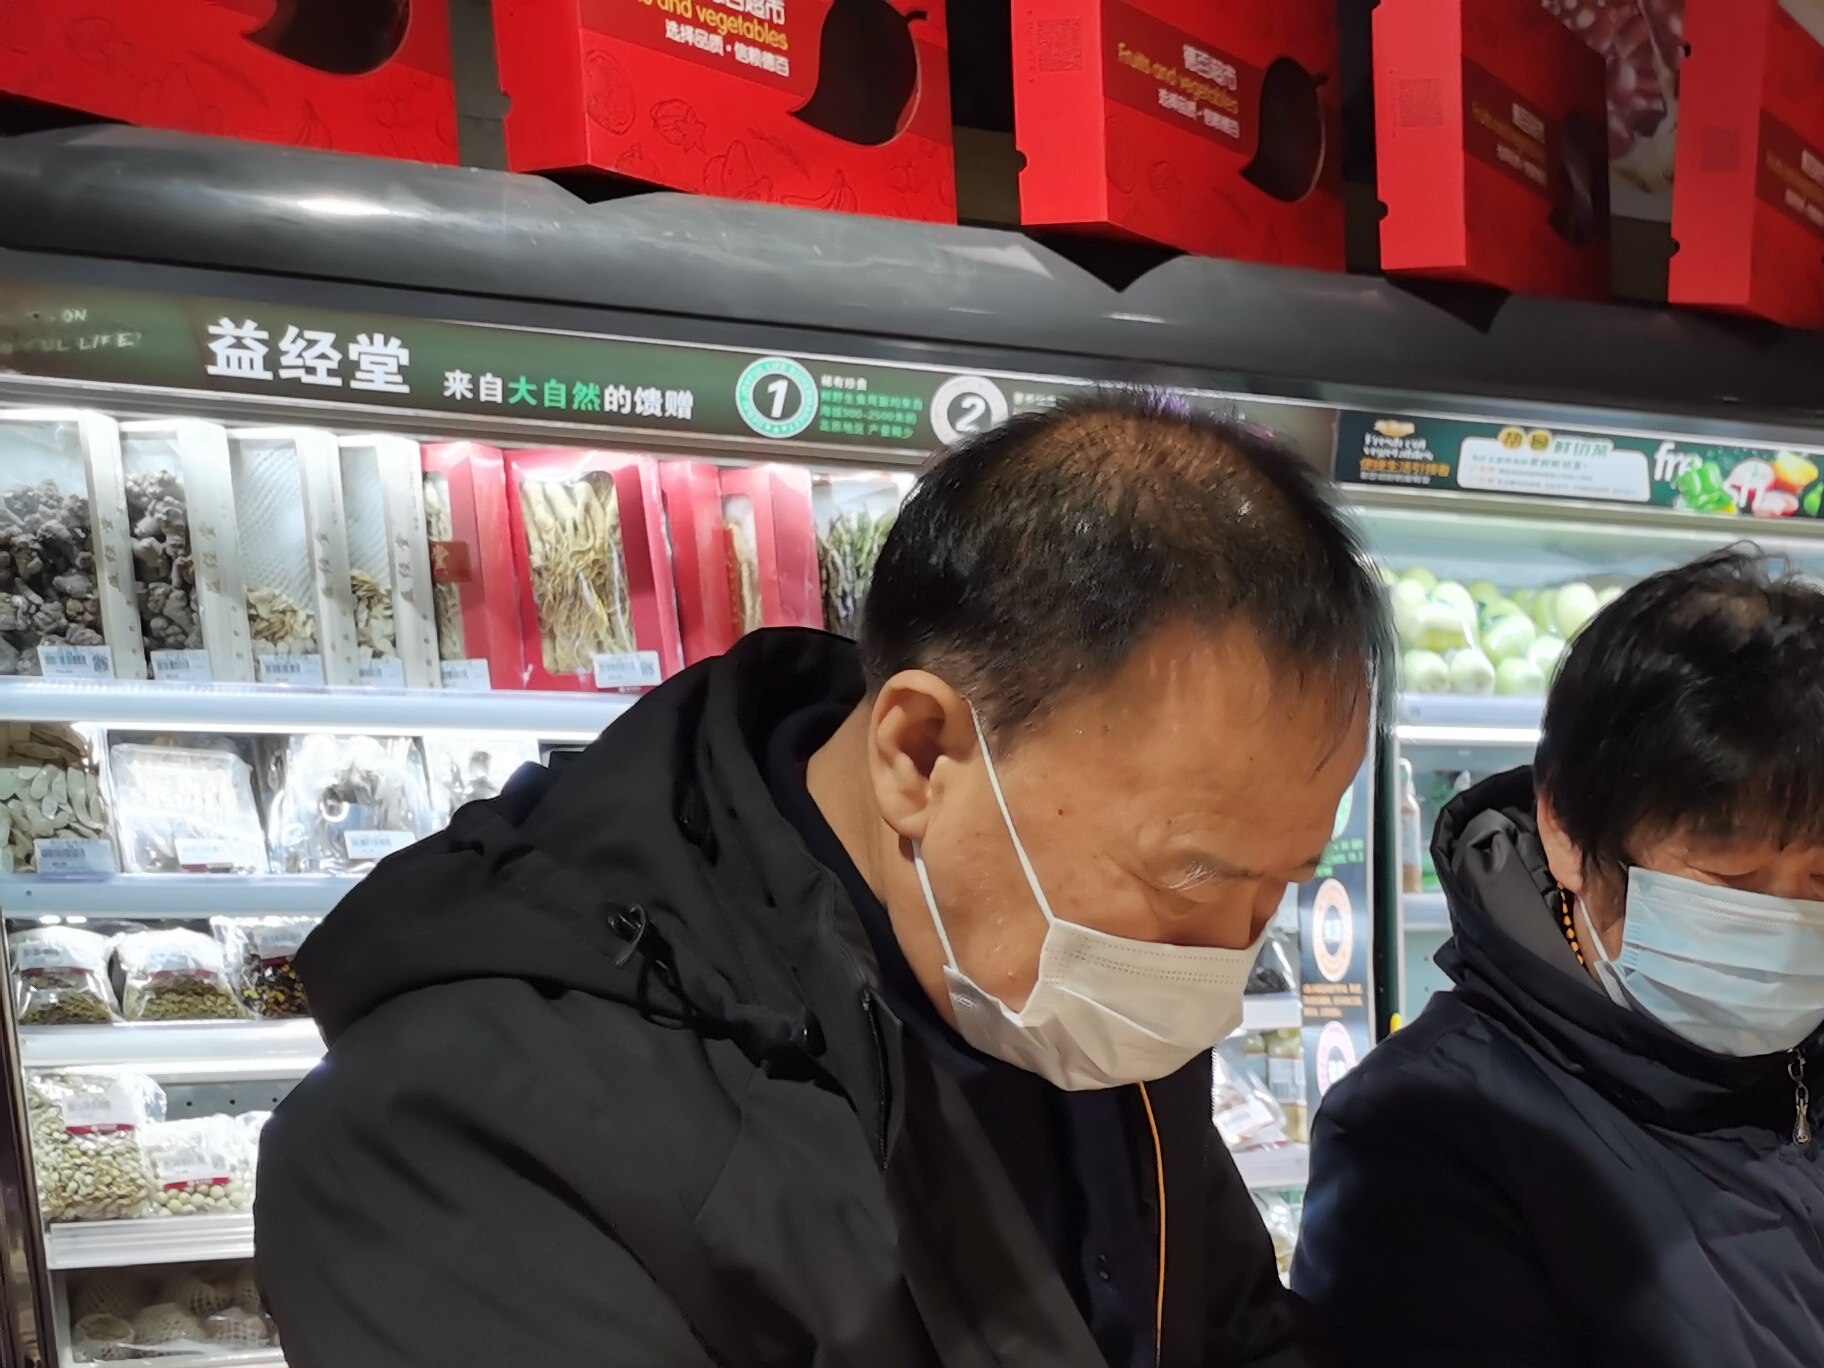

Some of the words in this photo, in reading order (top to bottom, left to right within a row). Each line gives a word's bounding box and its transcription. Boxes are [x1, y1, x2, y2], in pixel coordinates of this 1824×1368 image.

[696, 4, 789, 51] vegetables
[206, 317, 411, 394] 益经堂
[443, 369, 694, 421] 来自大自然的馈赠
[766, 378, 789, 419] 1
[955, 395, 987, 433] 2
